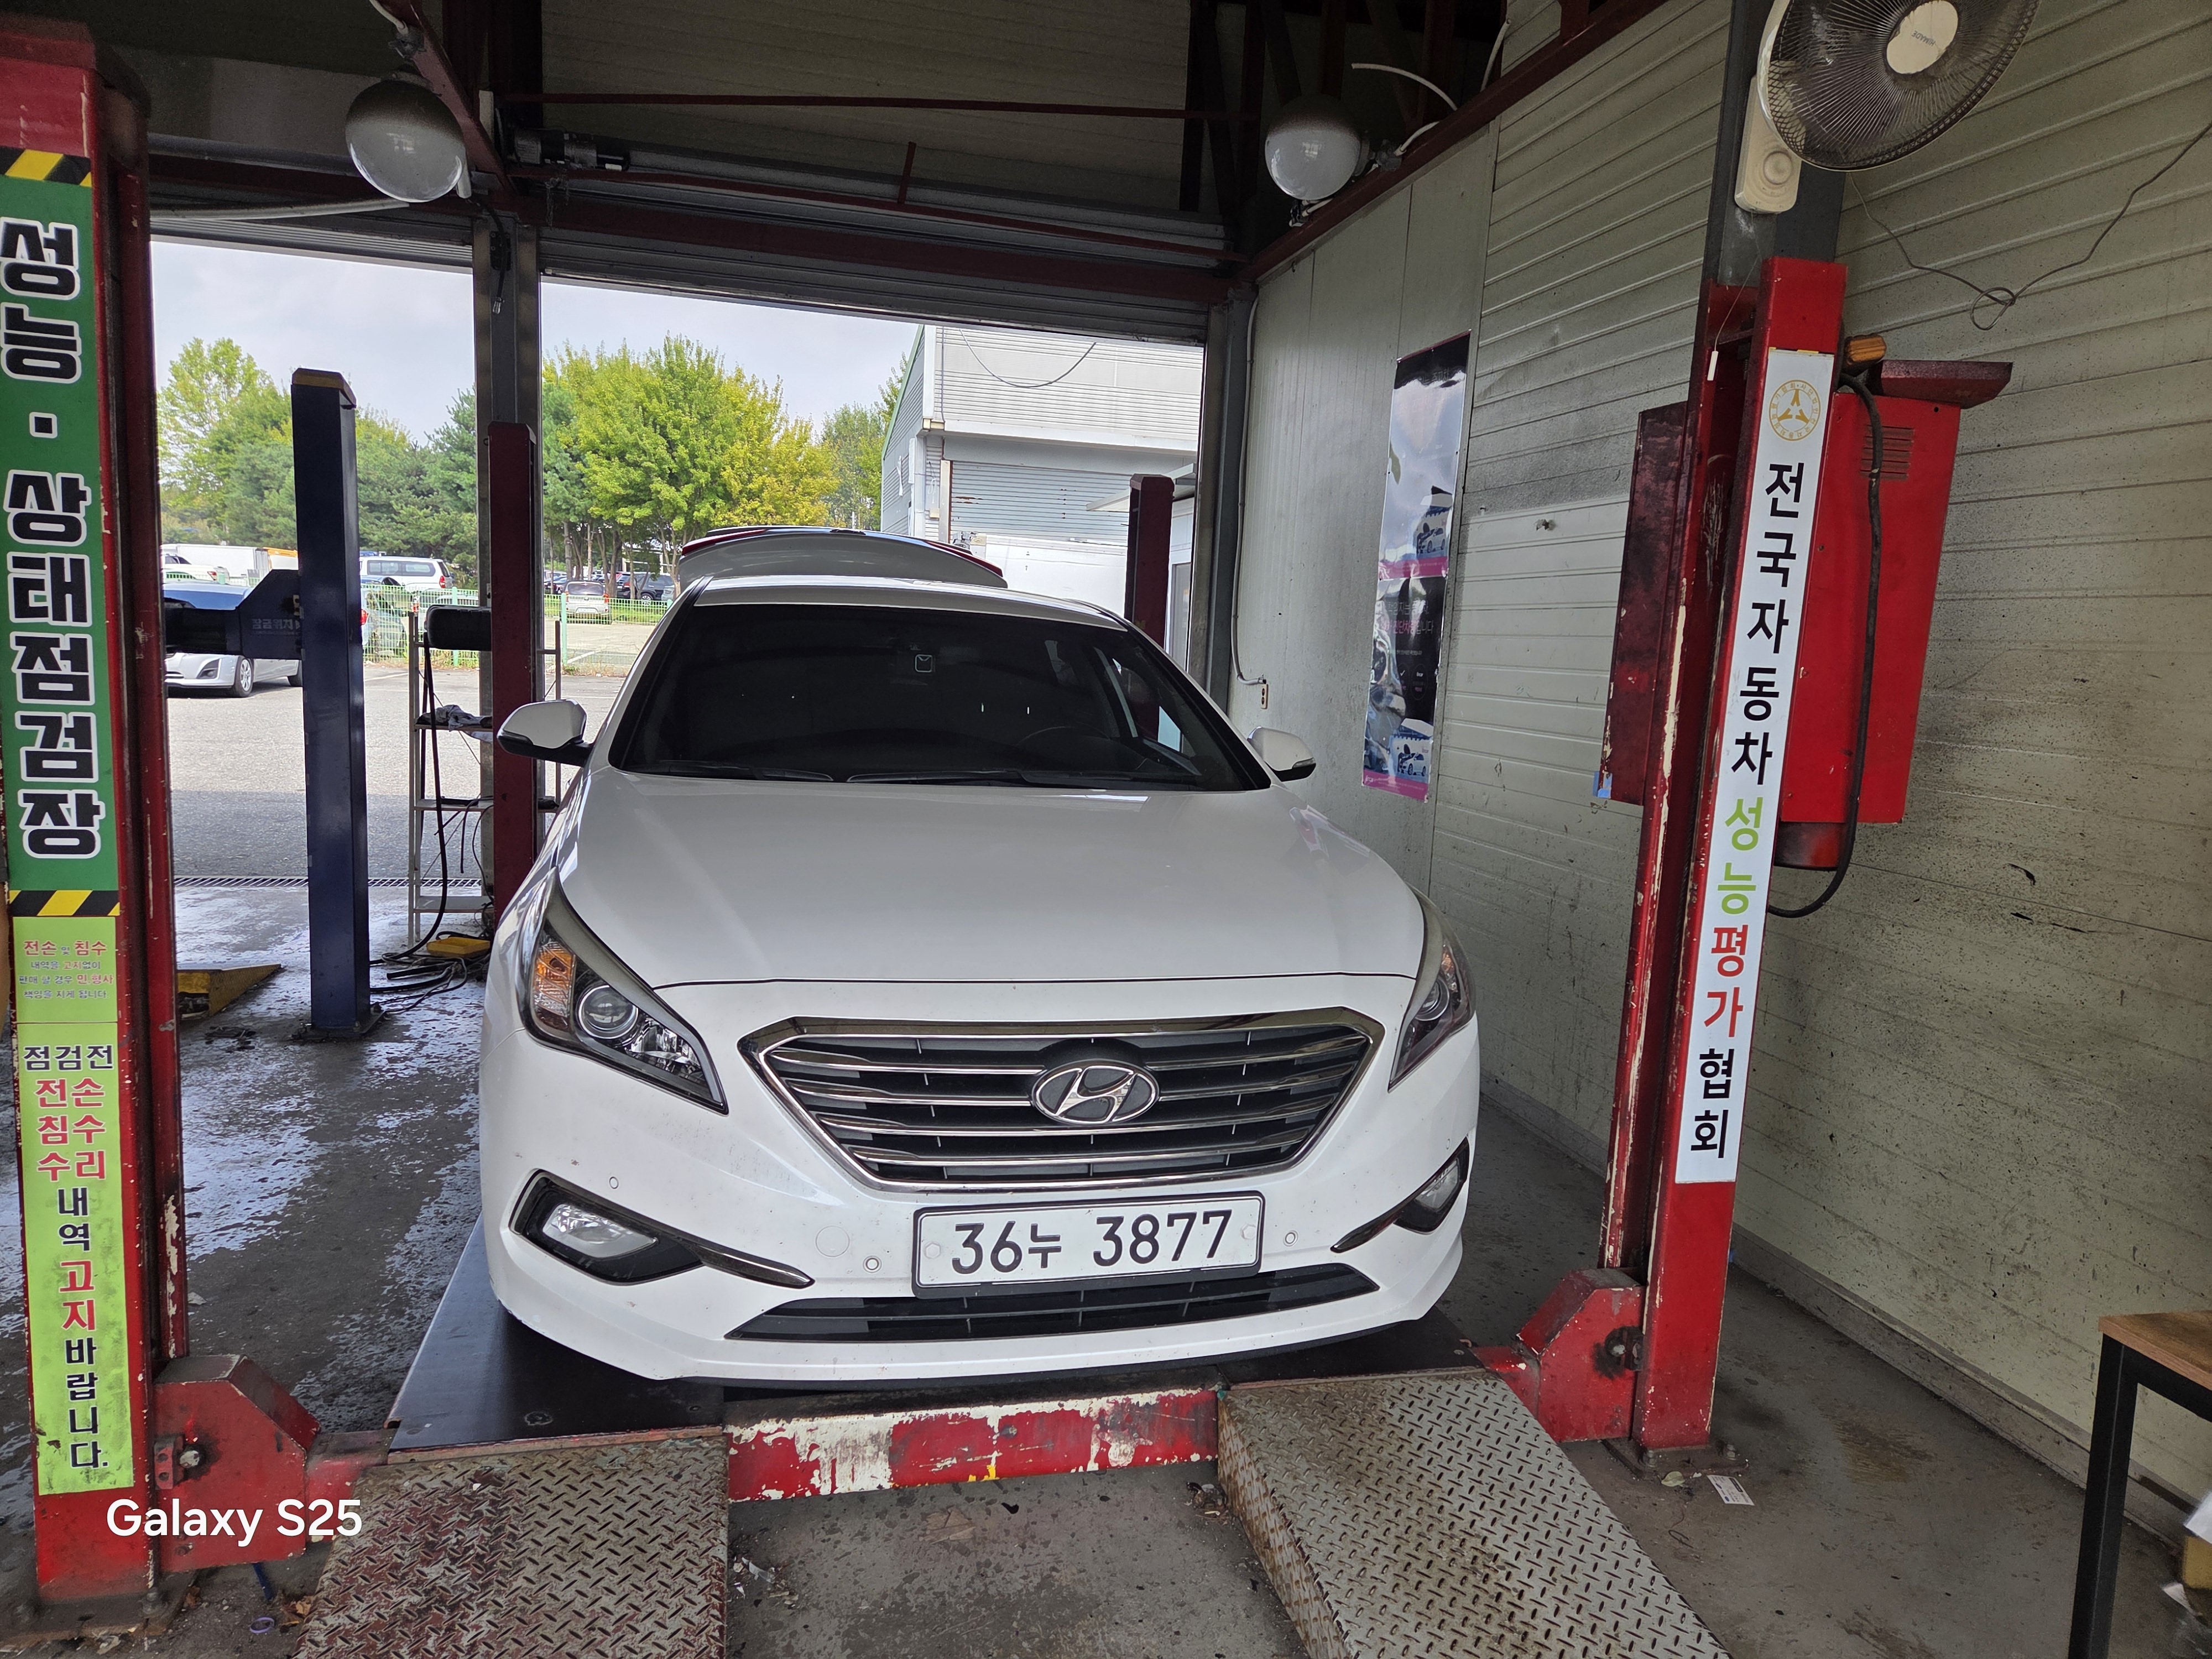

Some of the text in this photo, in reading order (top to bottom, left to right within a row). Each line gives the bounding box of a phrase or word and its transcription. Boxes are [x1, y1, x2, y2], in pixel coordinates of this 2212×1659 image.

[1911, 30, 1936, 46] HIMADE
[24, 941, 57, 956] 전손
[75, 941, 107, 956] 침수
[63, 961, 101, 970] 고지없이
[19, 975, 38, 984] 판매
[54, 975, 72, 984] 경우
[56, 990, 75, 999] 지게
[34, 1078, 106, 1108] 전손
[38, 1114, 106, 1145] 침수
[37, 1150, 106, 1182] 수리
[952, 1209, 1233, 1274] 36누 3877
